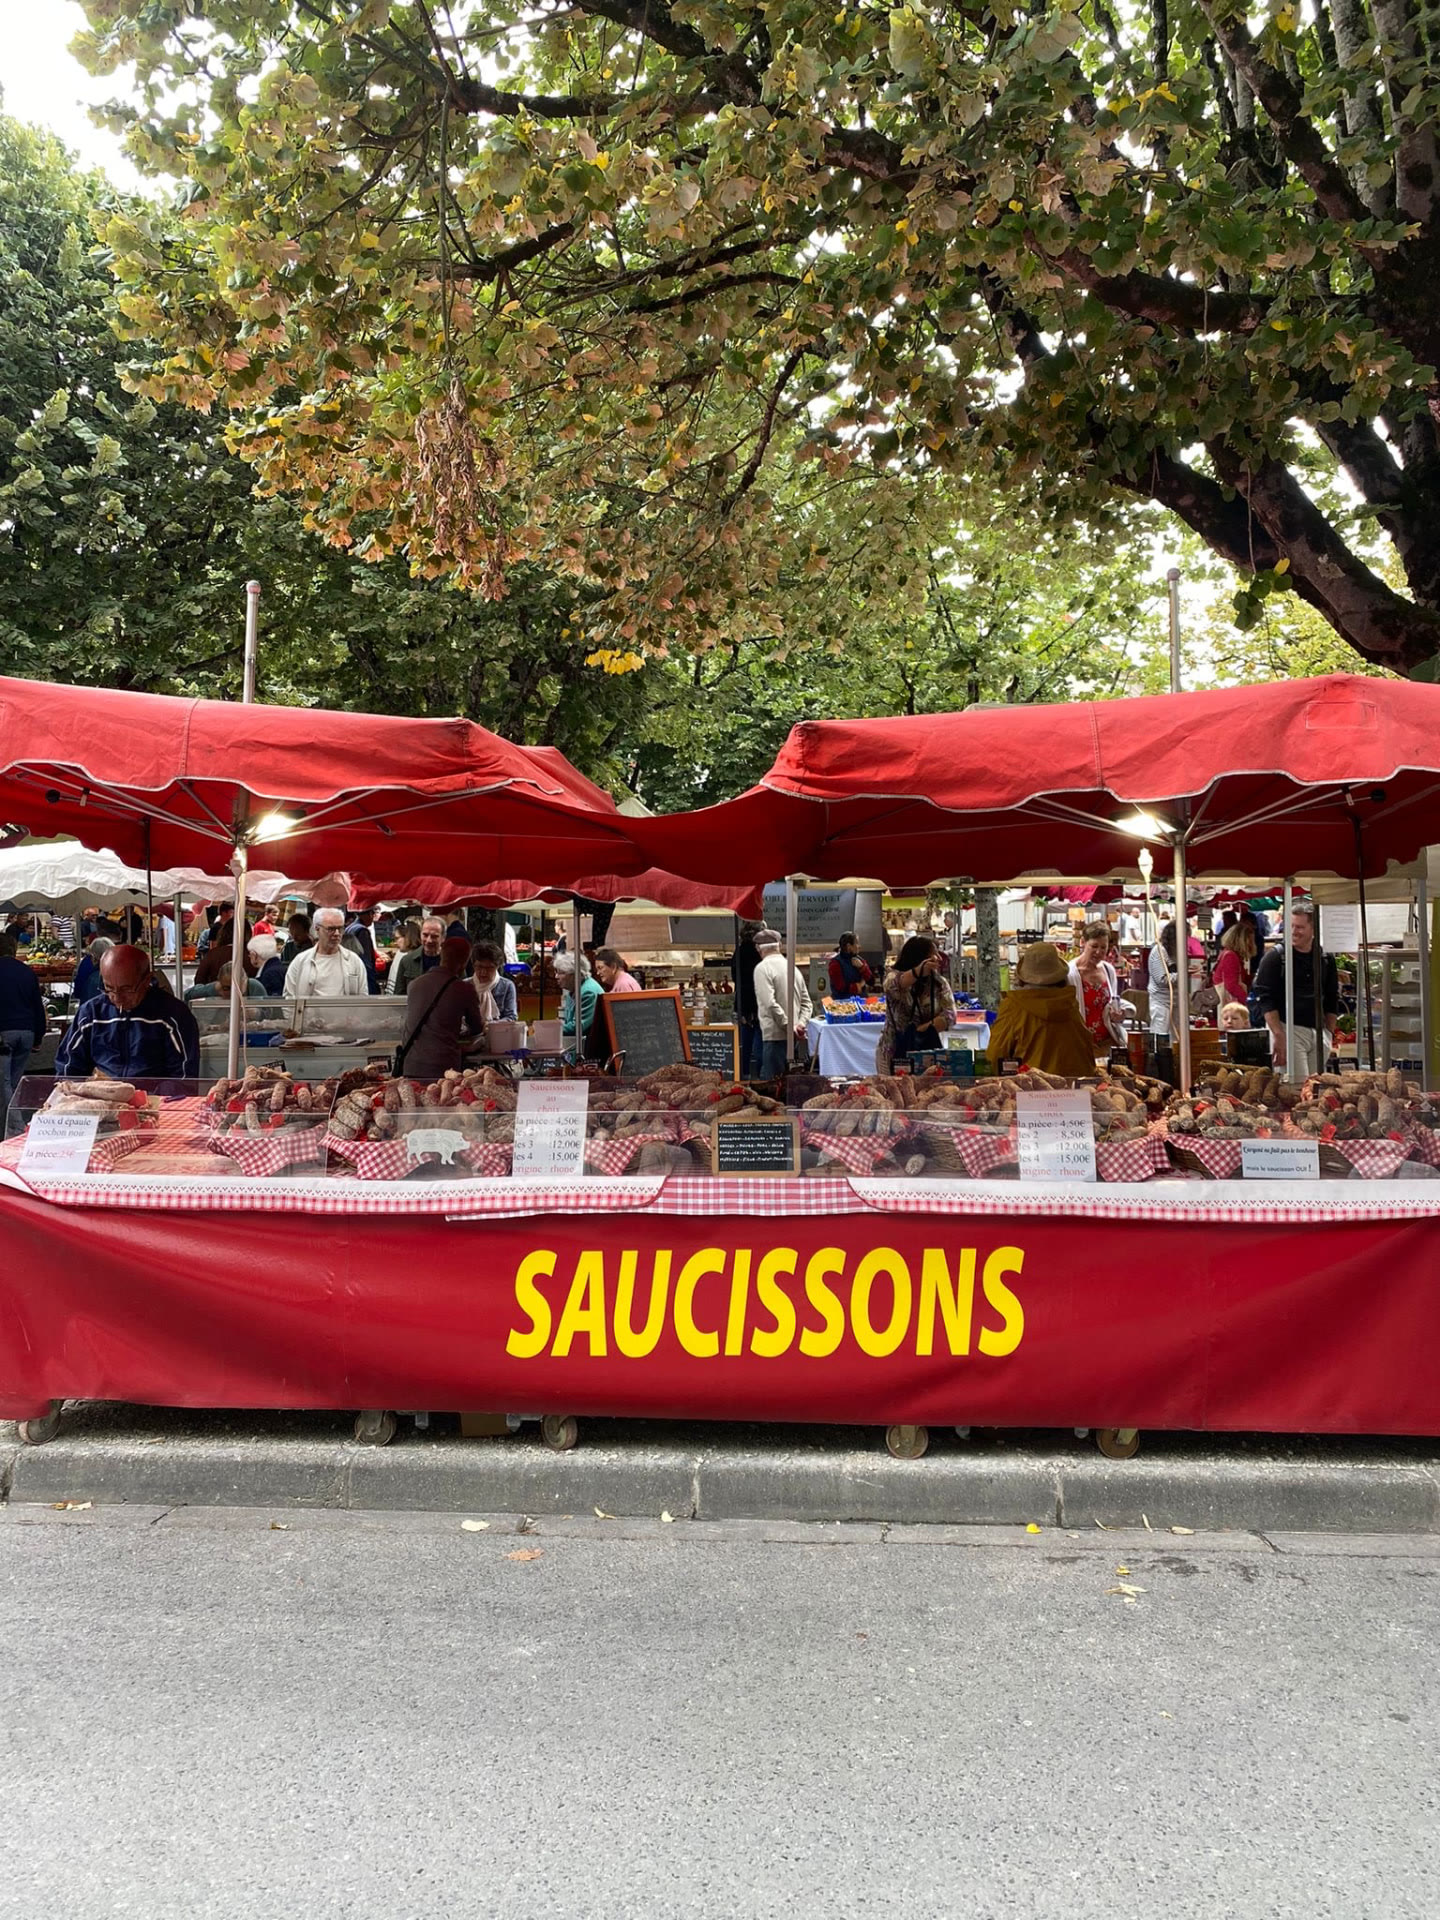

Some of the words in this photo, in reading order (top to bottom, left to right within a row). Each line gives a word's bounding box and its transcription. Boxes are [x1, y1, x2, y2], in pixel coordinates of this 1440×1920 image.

[529, 1083, 575, 1092] Saucissons
[1028, 1091, 1076, 1099] Saucissons
[515, 1117, 524, 1125] la
[525, 1116, 548, 1126] pièce
[555, 1117, 579, 1126] 4,50€
[1018, 1120, 1026, 1128] la
[1028, 1120, 1052, 1129] pièce
[1060, 1120, 1086, 1128] 4,50€
[37, 1128, 67, 1137] cochon
[515, 1128, 527, 1137] les
[529, 1128, 535, 1137] 2
[554, 1128, 579, 1138] 8,50€
[1019, 1131, 1031, 1139] les
[1033, 1131, 1039, 1139] 2
[1061, 1131, 1087, 1140] 8,50€
[514, 1140, 526, 1148] les
[528, 1140, 534, 1149] 3
[1019, 1142, 1031, 1150] les
[1034, 1142, 1040, 1150] 3
[513, 1151, 526, 1160] les
[526, 1152, 533, 1160] 4
[1019, 1154, 1032, 1163] les
[1033, 1154, 1040, 1163] 4
[512, 1165, 542, 1175] origine
[550, 1164, 575, 1173] rhone
[1020, 1168, 1052, 1177] origine
[1060, 1167, 1086, 1176] rhone
[505, 1246, 1026, 1358] SAUCISSONS
